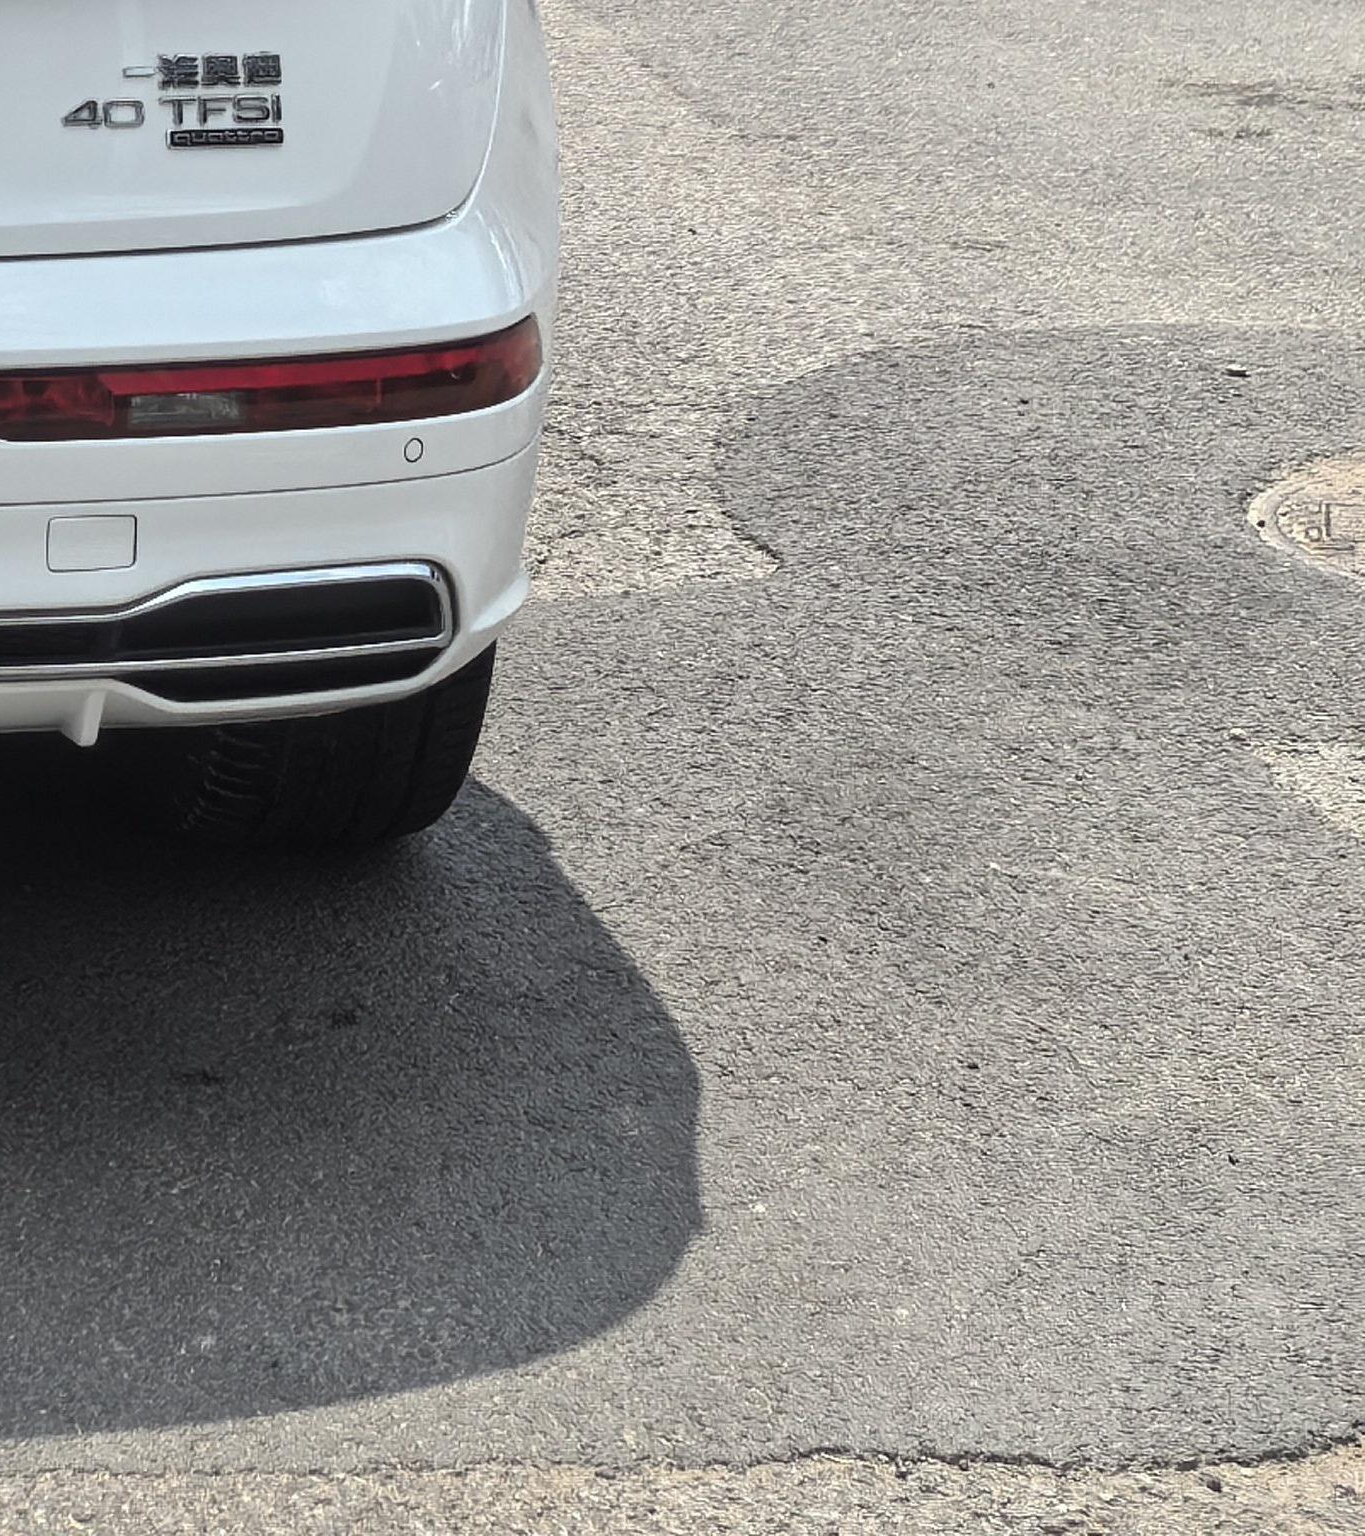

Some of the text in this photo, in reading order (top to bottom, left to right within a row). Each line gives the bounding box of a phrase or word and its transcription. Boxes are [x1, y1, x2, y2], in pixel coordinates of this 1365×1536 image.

[61, 93, 283, 130] 40 TFSI
[172, 129, 279, 146] quattro
